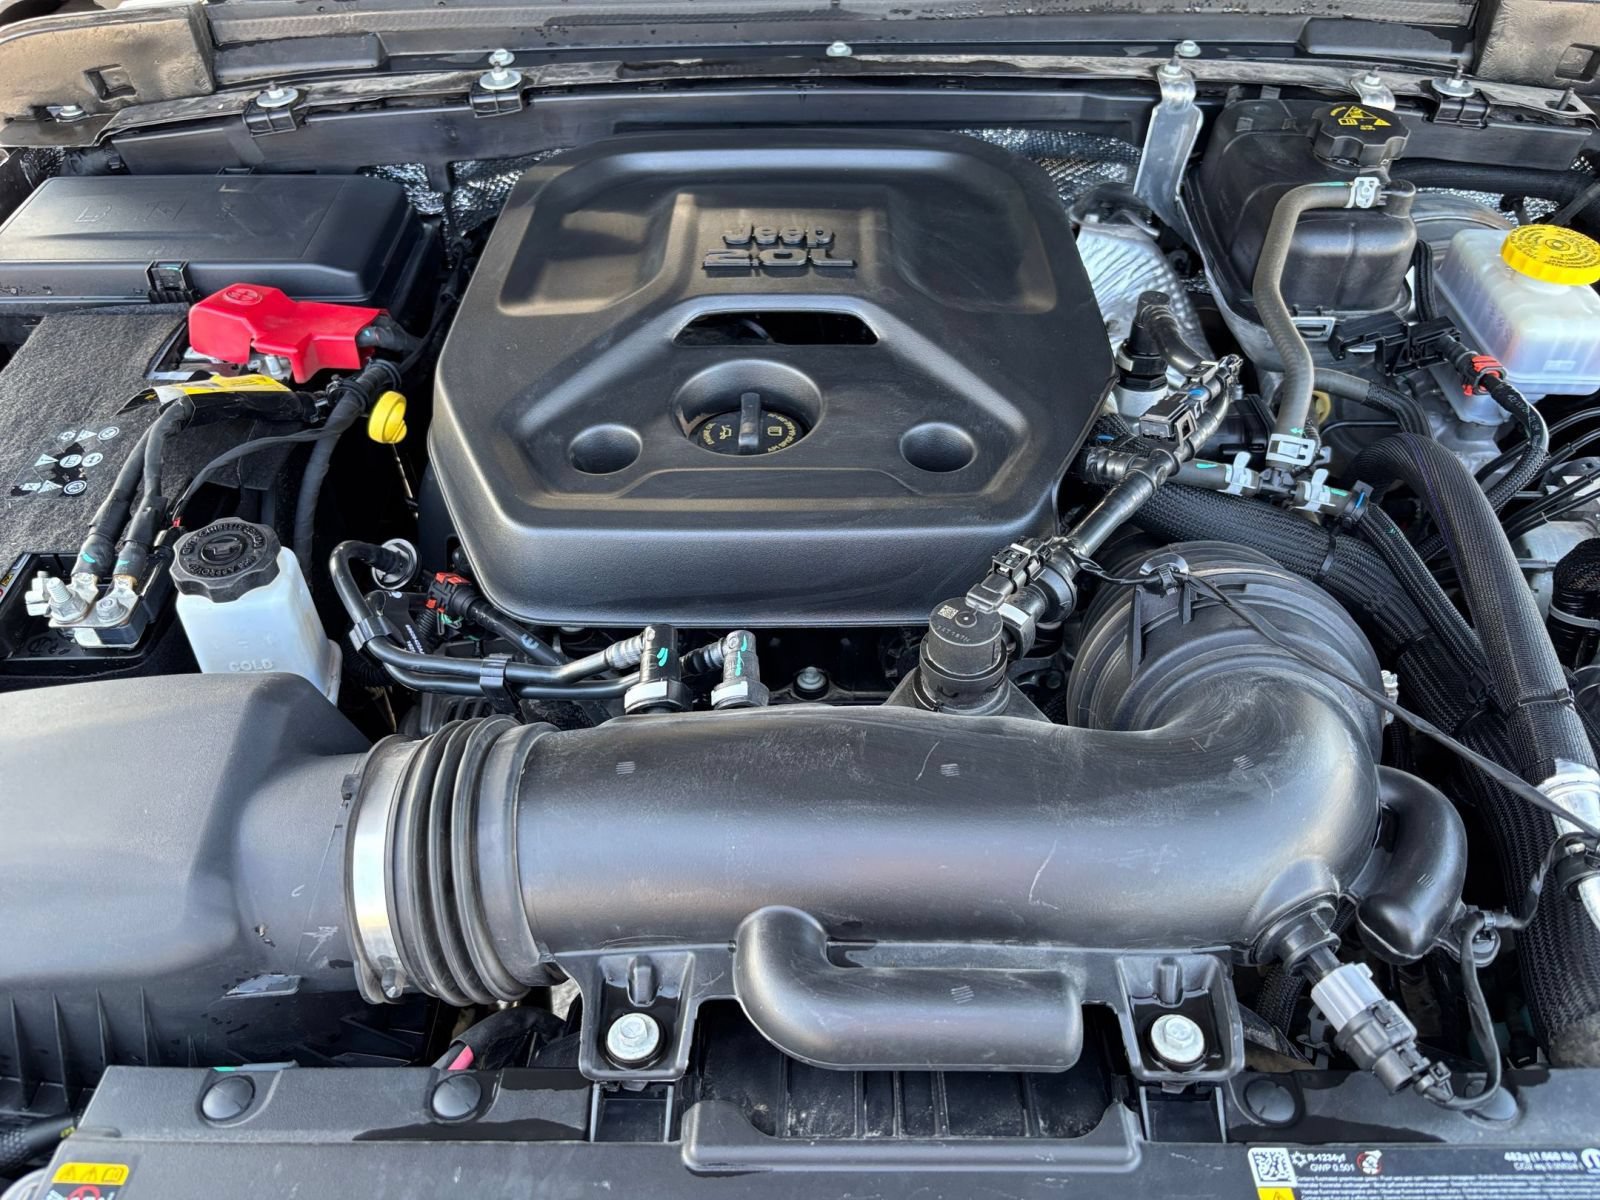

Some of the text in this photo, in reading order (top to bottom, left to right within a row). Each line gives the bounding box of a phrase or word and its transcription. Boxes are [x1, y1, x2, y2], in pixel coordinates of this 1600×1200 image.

[723, 224, 834, 248] Jeep
[704, 249, 859, 268] 2.0L
[228, 658, 274, 672] COLD
[1310, 1163, 1356, 1172] GWP 0.501
